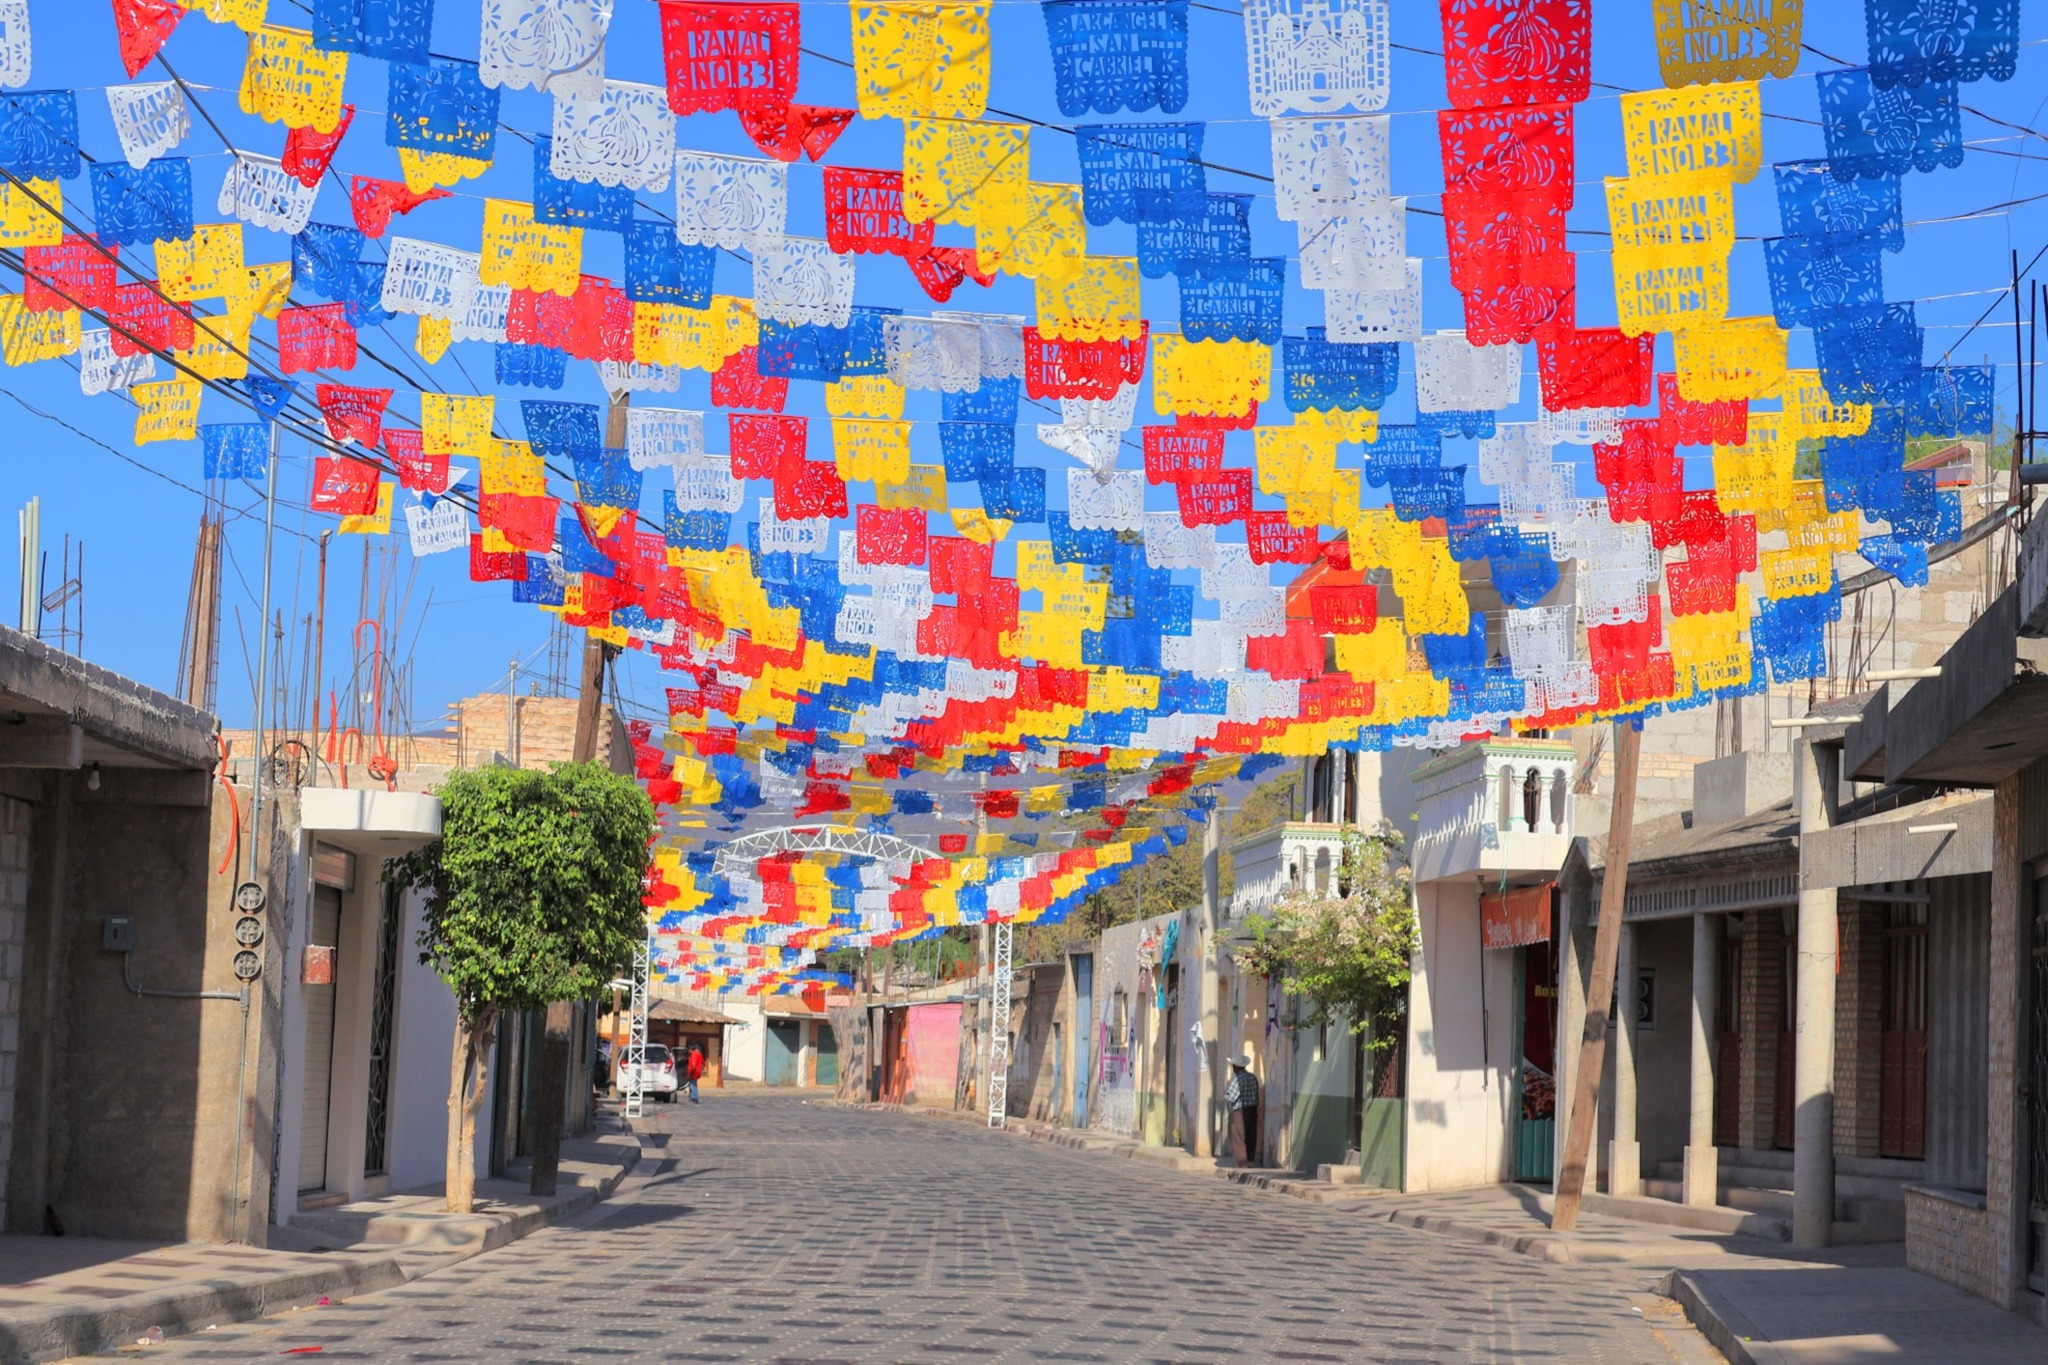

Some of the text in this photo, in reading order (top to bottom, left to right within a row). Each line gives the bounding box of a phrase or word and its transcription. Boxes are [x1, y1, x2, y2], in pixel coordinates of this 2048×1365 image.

[1071, 11, 1167, 31] ARCANGEL
[1681, 0, 1773, 29] RAMAL
[688, 30, 770, 58] RAMAL
[1089, 33, 1139, 52] SAN
[1684, 29, 1776, 63] NO.33
[690, 59, 775, 90] NO.33
[130, 82, 180, 123] RAMA
[1649, 112, 1732, 145] RAMAL
[1098, 133, 1187, 151] ARCANGEL
[1114, 152, 1161, 170] SAN
[1652, 139, 1737, 175] NO.33
[243, 161, 298, 196] RAMAL
[1101, 172, 1171, 190] GABRIEL
[239, 184, 297, 219] NO.33
[846, 186, 903, 212] RAMA
[1631, 196, 1708, 226] RAMAL
[847, 212, 915, 241] NO.33
[1634, 221, 1711, 246] NO.33
[1156, 232, 1220, 250] GABRIEL
[404, 258, 454, 286] RAMA
[1635, 266, 1704, 293] RAMAL
[400, 279, 452, 307] NO.33
[471, 288, 512, 308] RAMA
[1207, 282, 1248, 298] SAN
[1197, 299, 1256, 315] GABRIEL
[1637, 288, 1708, 317] NO.33
[617, 363, 668, 382] NO.33
[641, 423, 689, 439] RAMAL
[1377, 428, 1422, 440] ARCANG
[642, 439, 691, 457] NO.33
[1159, 436, 1209, 453] RAMAL
[1159, 454, 1208, 472] NO.33
[688, 468, 731, 485] RAMAL
[687, 485, 731, 502] NO.33
[1190, 483, 1237, 498] RAMAL
[1194, 497, 1239, 515] NO.33
[773, 527, 817, 542] NO.33
[1260, 523, 1305, 537] RAMAL
[1801, 531, 1847, 546] NO.33
[846, 607, 874, 620] RAM
[846, 621, 876, 636] NO.3
